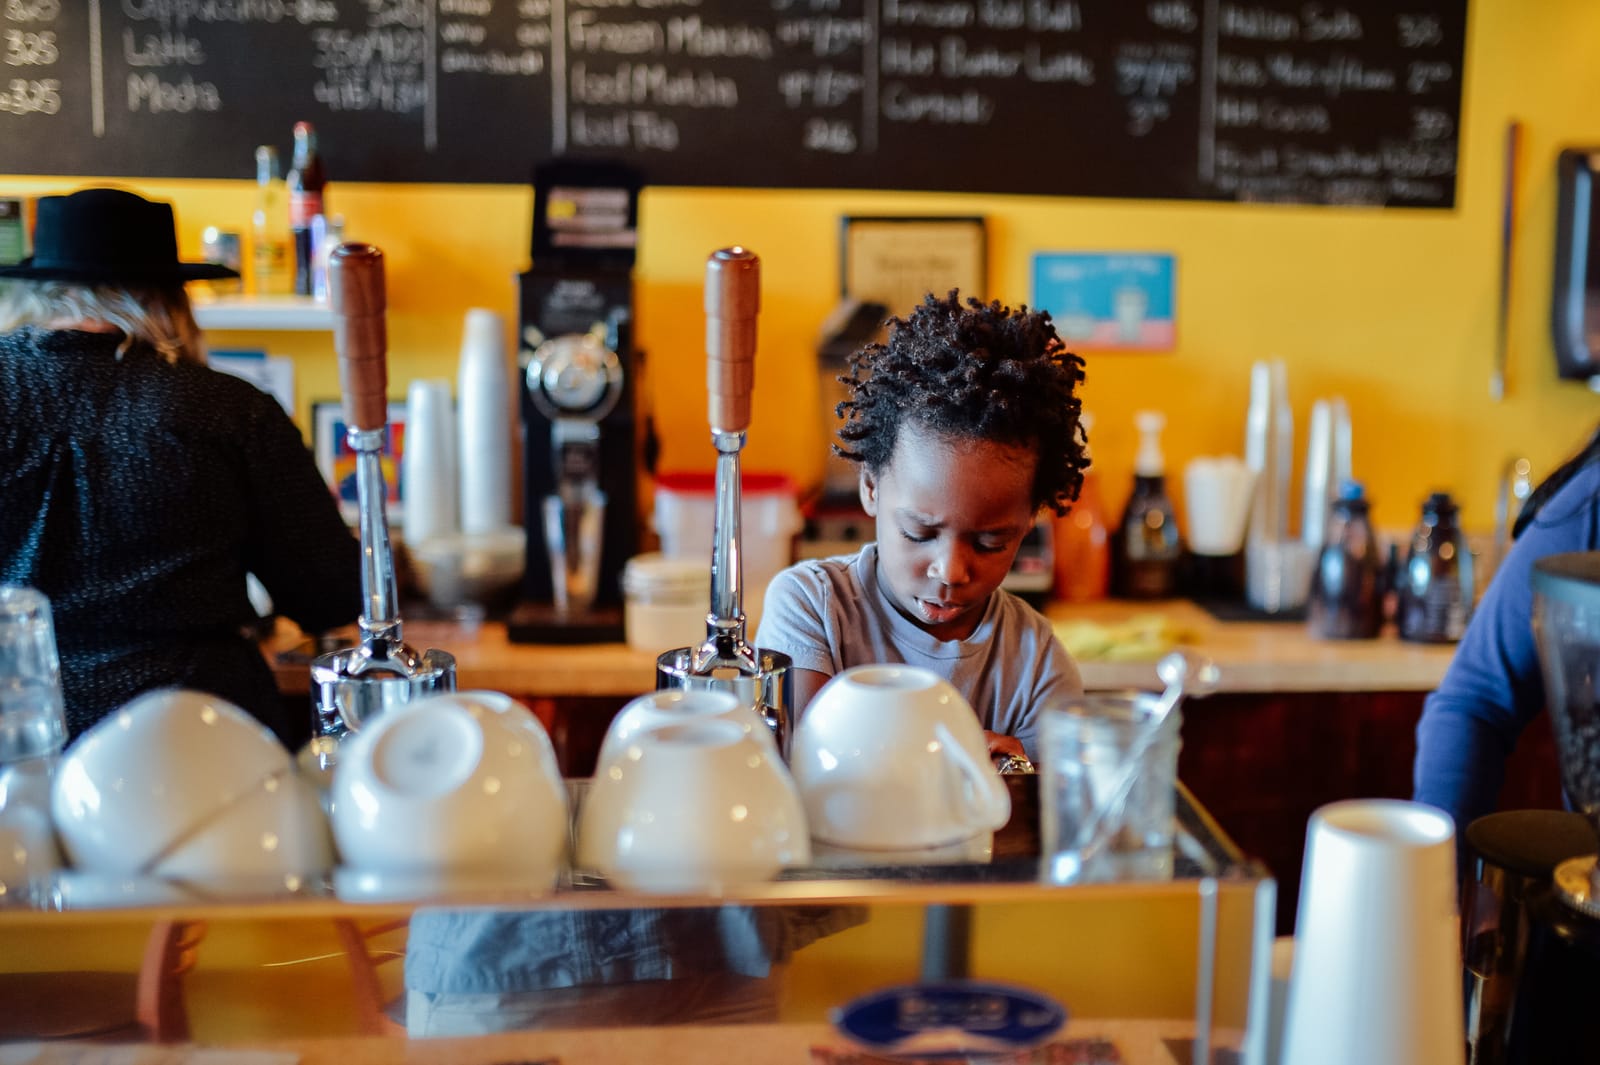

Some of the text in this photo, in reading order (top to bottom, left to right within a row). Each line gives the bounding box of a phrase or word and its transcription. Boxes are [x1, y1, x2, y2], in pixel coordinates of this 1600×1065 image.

[123, 27, 207, 66] Latte
[568, 9, 665, 54] Frozen
[127, 71, 221, 112] Mocha
